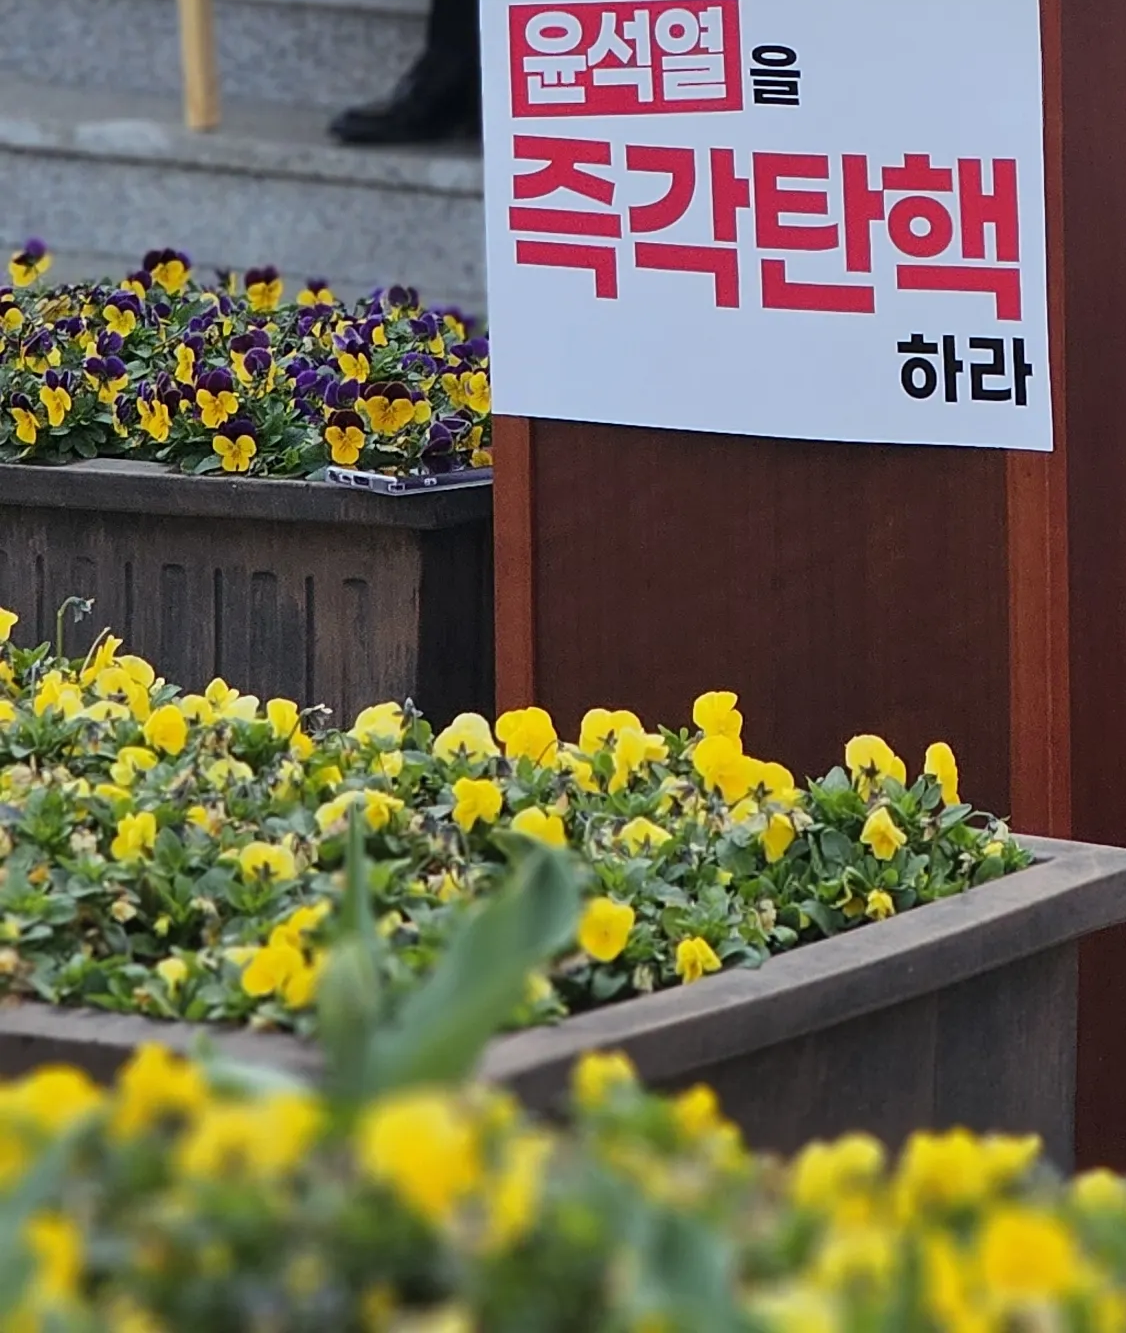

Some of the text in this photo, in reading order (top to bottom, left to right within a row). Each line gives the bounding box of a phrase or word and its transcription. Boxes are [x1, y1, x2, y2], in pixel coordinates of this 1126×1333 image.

[521, 6, 801, 107] 윤석열을
[508, 134, 1023, 321] 즉각탄핵
[897, 333, 1034, 406] 하라
